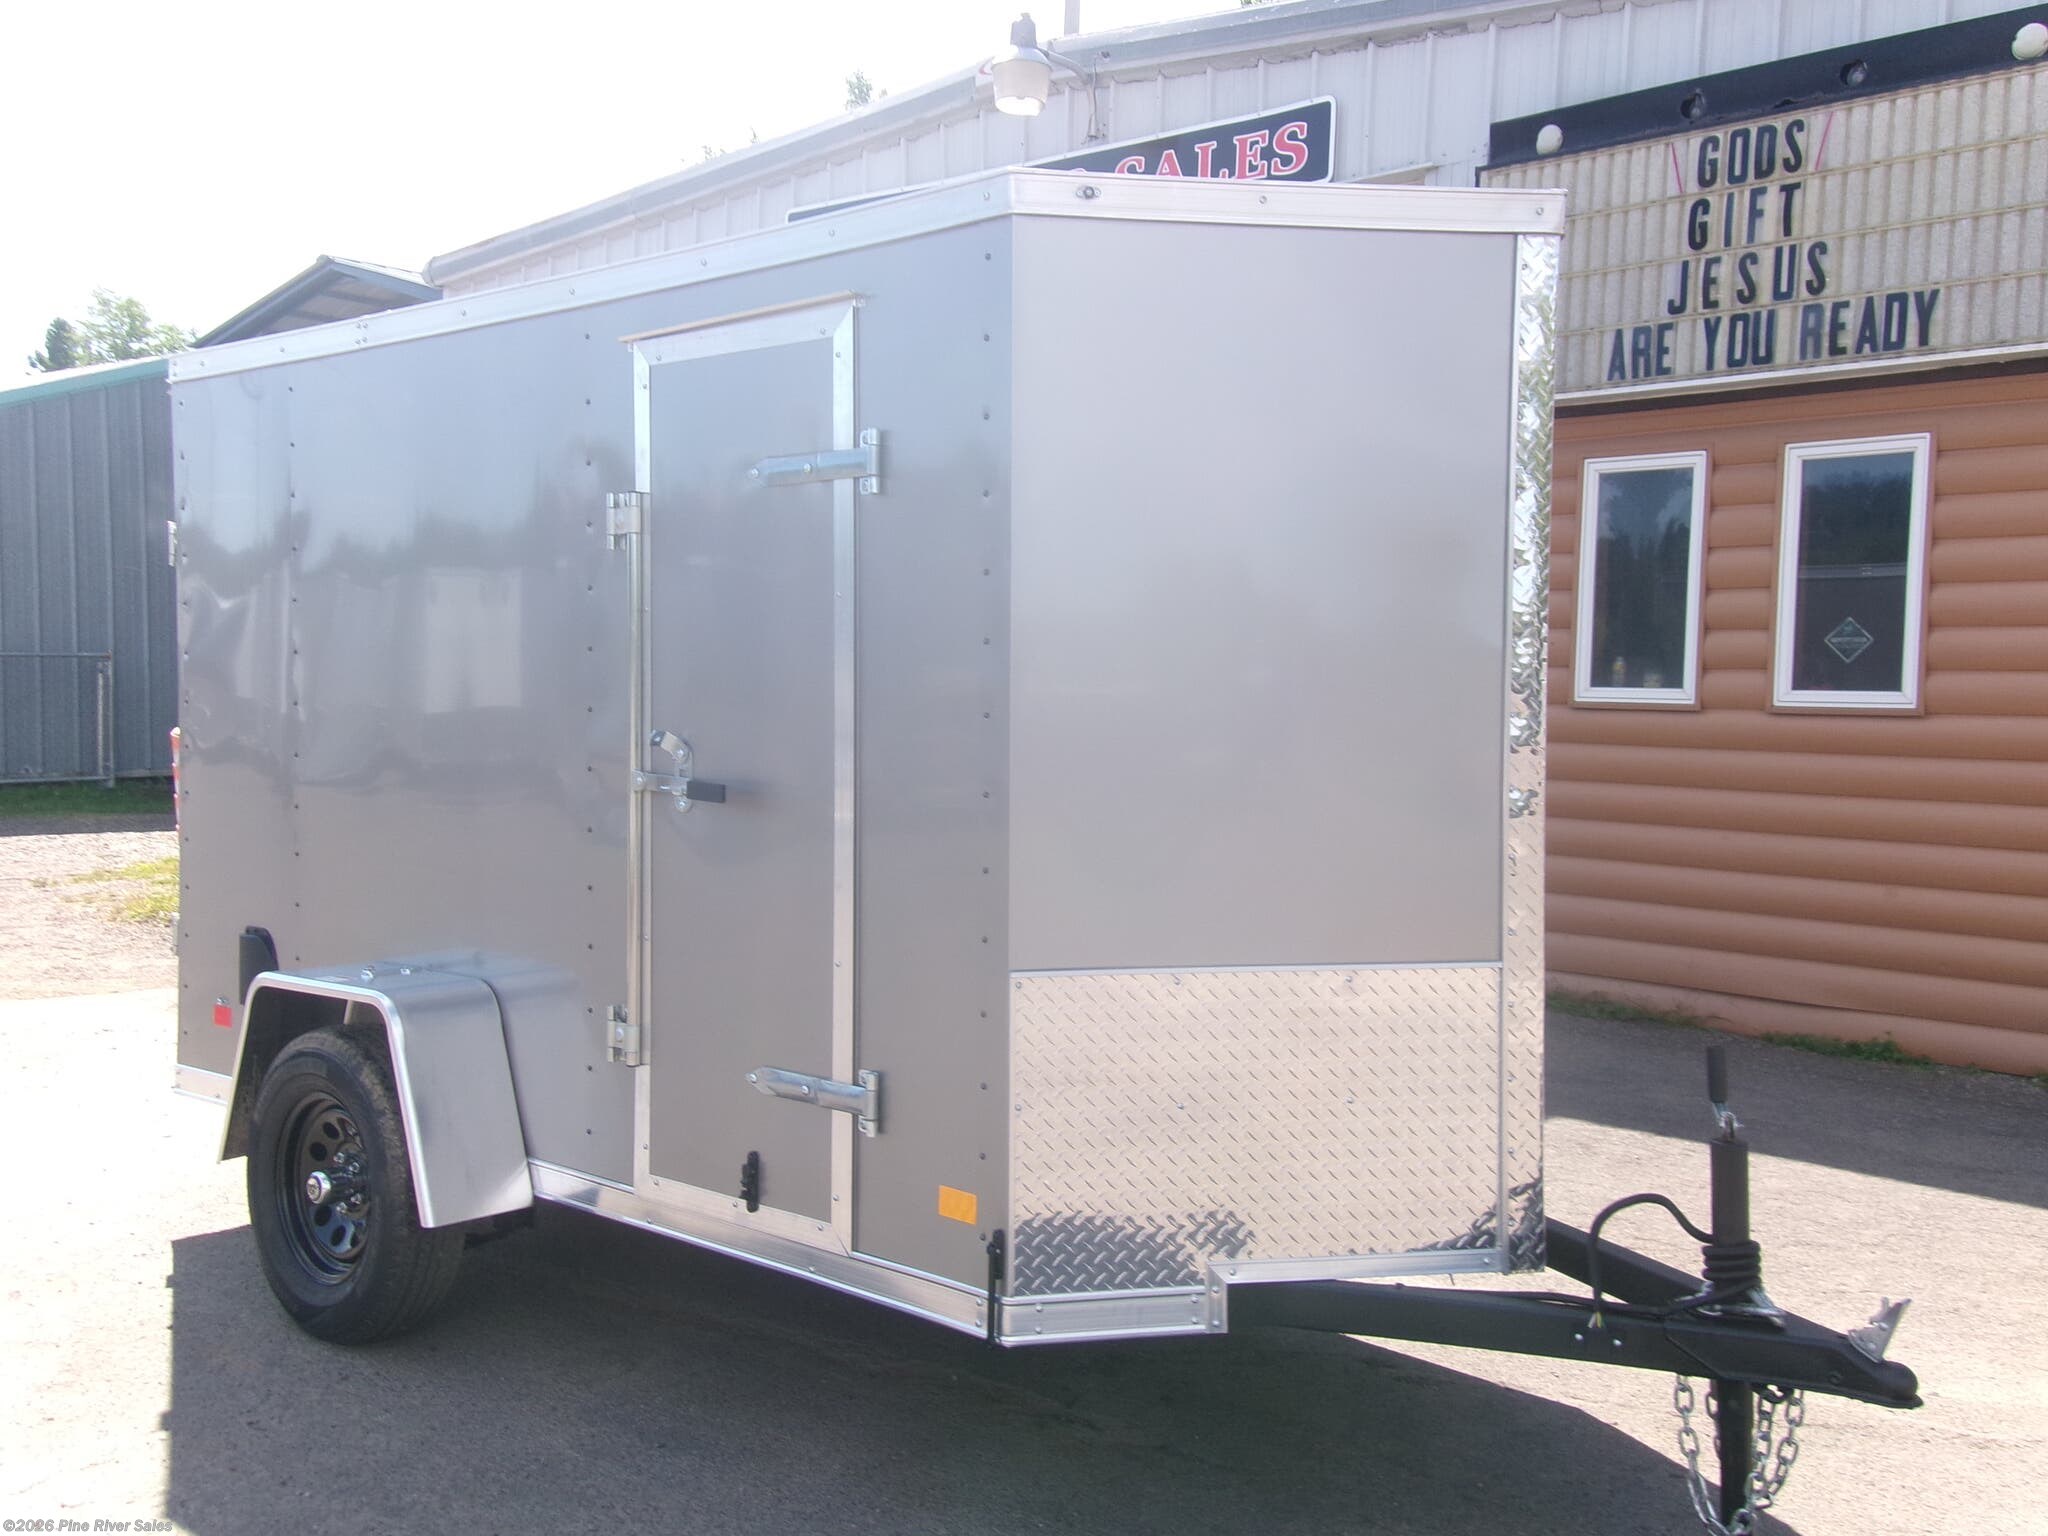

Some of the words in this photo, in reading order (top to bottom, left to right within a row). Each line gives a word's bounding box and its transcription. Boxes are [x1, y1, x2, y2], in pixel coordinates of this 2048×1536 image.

[1697, 118, 1805, 188] GODS
[1688, 182, 1802, 251] GIFT
[1667, 241, 1828, 315] JESUS
[1607, 322, 1675, 382] ARE
[1703, 308, 1776, 371] YOU
[1800, 288, 1940, 361] READY
